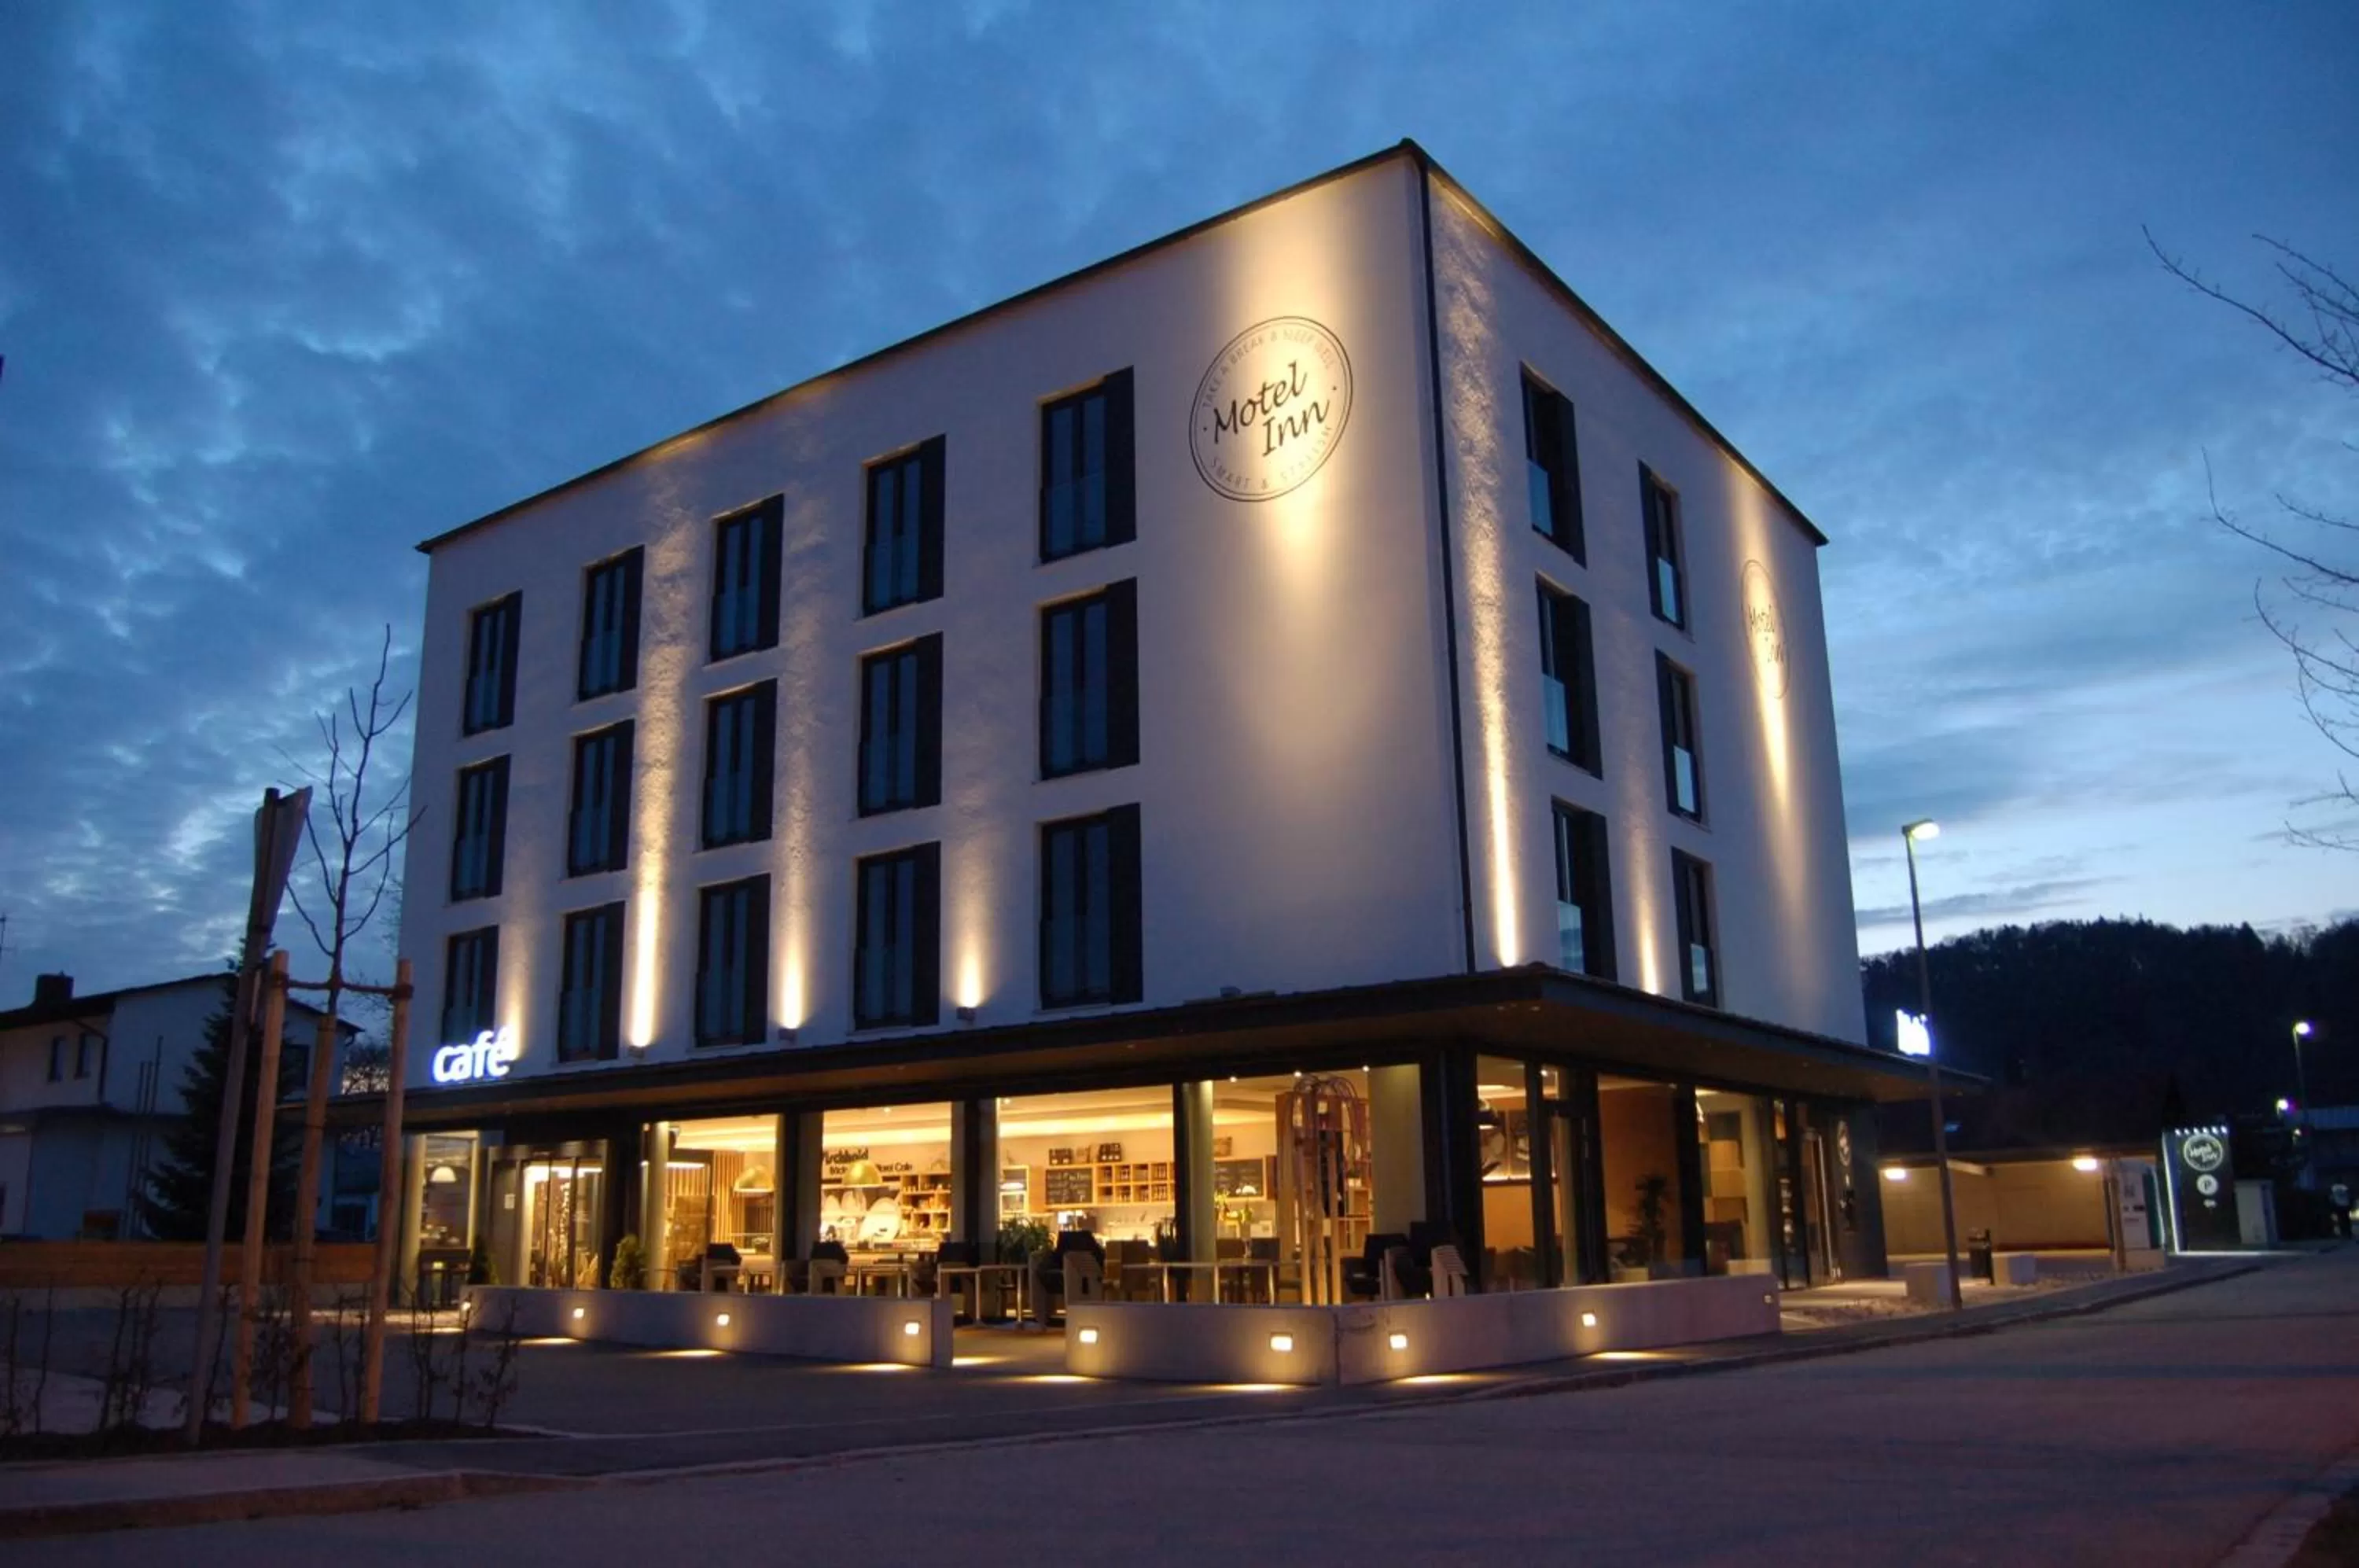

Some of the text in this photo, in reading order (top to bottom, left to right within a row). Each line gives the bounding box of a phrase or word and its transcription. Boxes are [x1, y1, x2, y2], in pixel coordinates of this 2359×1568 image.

[1213, 359, 1308, 445] Motel
[1262, 399, 1330, 457] Inn
[433, 1026, 517, 1082] café
